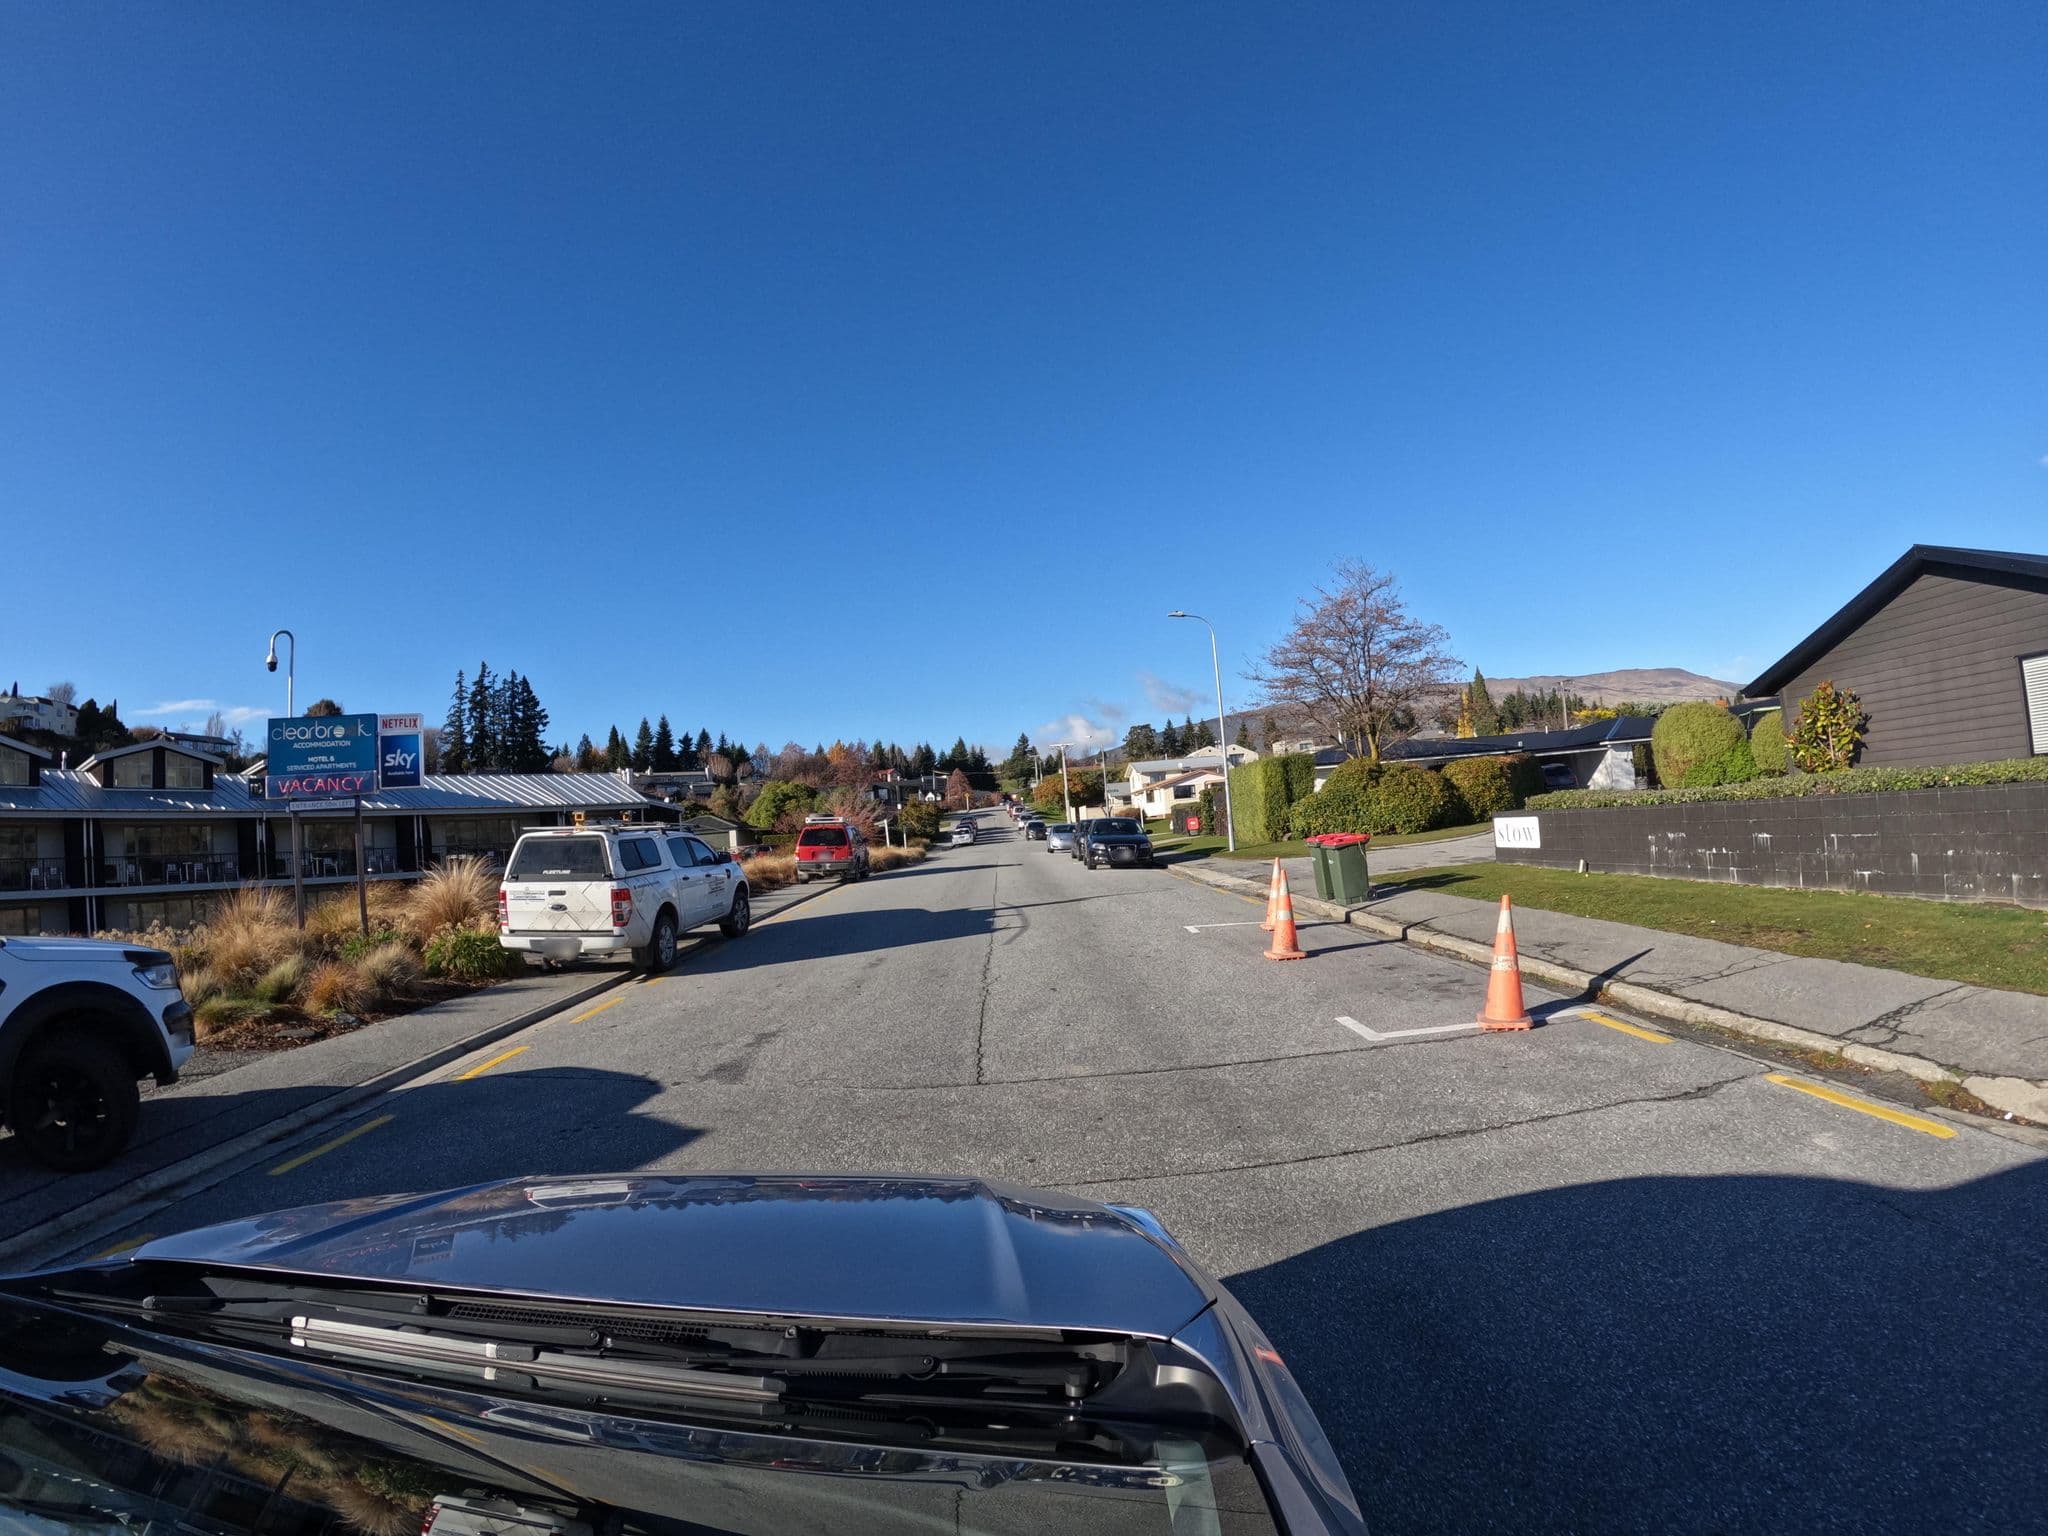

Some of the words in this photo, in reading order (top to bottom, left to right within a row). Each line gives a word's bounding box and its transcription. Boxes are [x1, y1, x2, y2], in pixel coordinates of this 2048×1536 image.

[382, 717, 419, 729] NETFLIX
[293, 740, 352, 749] ACCOMMODATION
[383, 748, 416, 768] sky
[286, 764, 315, 772] SERVICED
[316, 762, 357, 770] APARTMENTS
[278, 776, 364, 793] VACANCY
